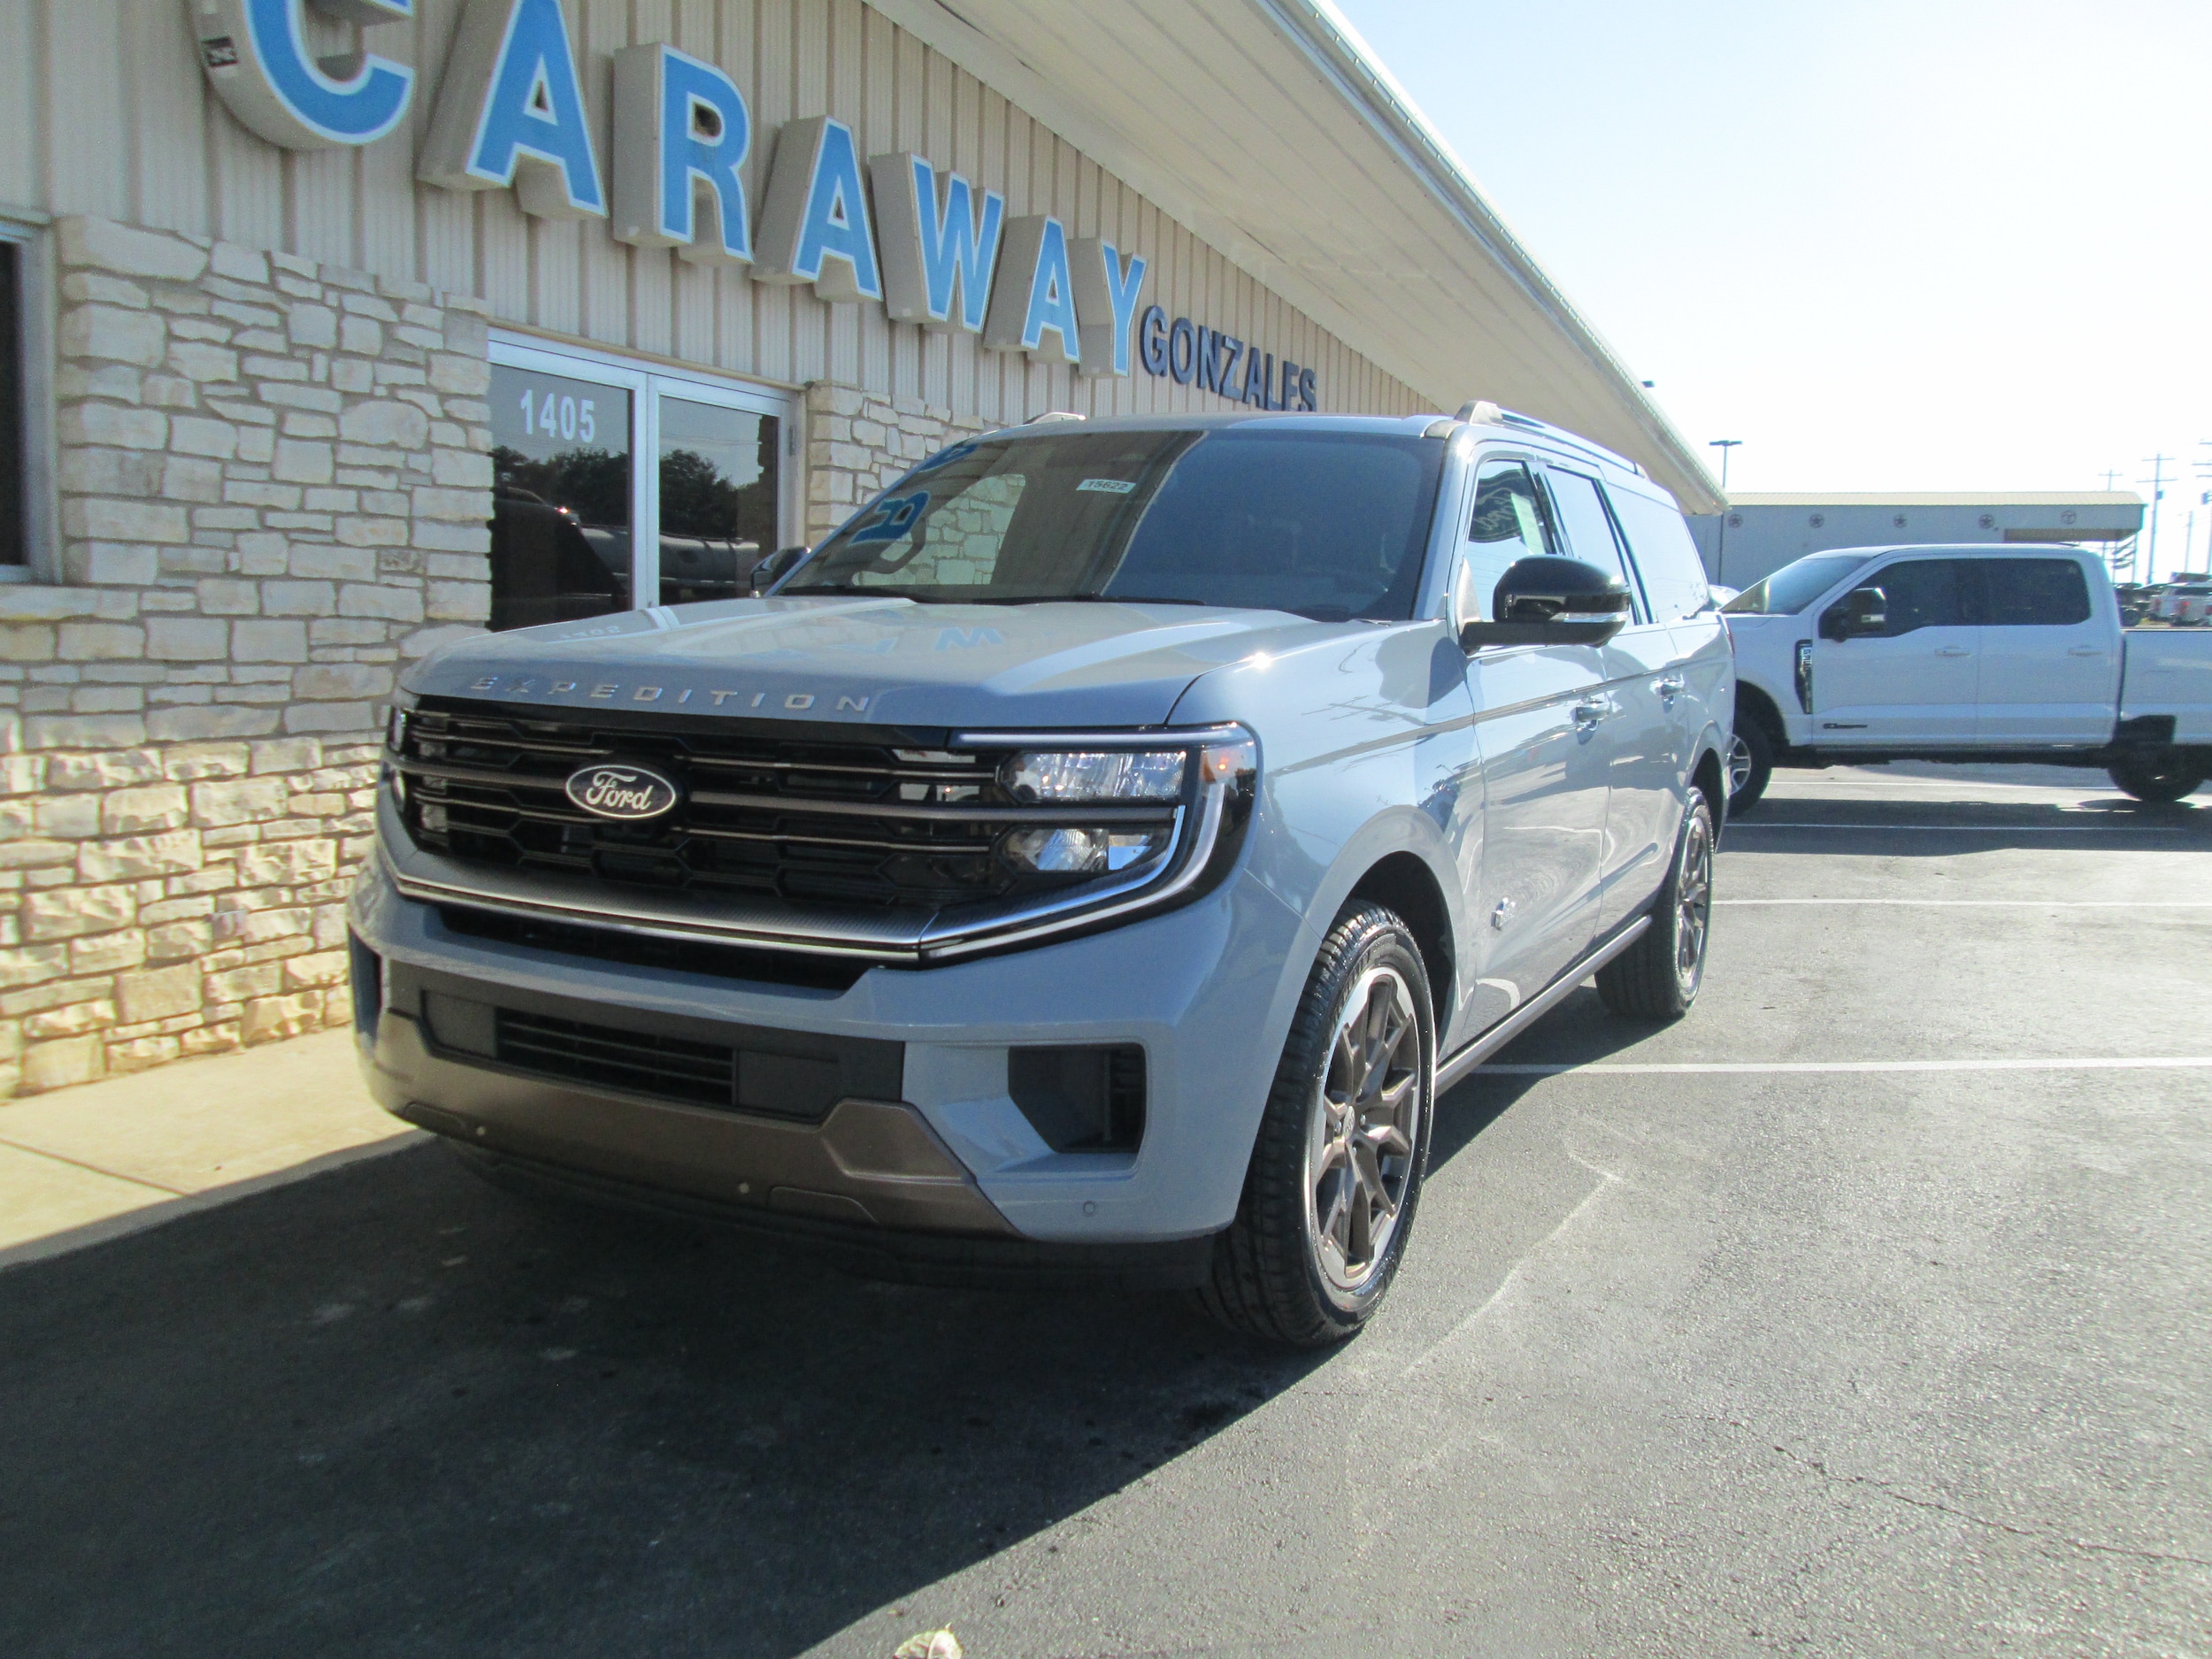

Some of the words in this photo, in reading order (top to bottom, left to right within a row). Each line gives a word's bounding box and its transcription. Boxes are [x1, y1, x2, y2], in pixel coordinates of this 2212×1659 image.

[242, 0, 1148, 378] CARAWAY
[1140, 305, 1317, 412] GONZALES
[520, 389, 595, 442] 1405
[470, 676, 870, 712] EXPEDITION
[586, 771, 654, 810] Ford
